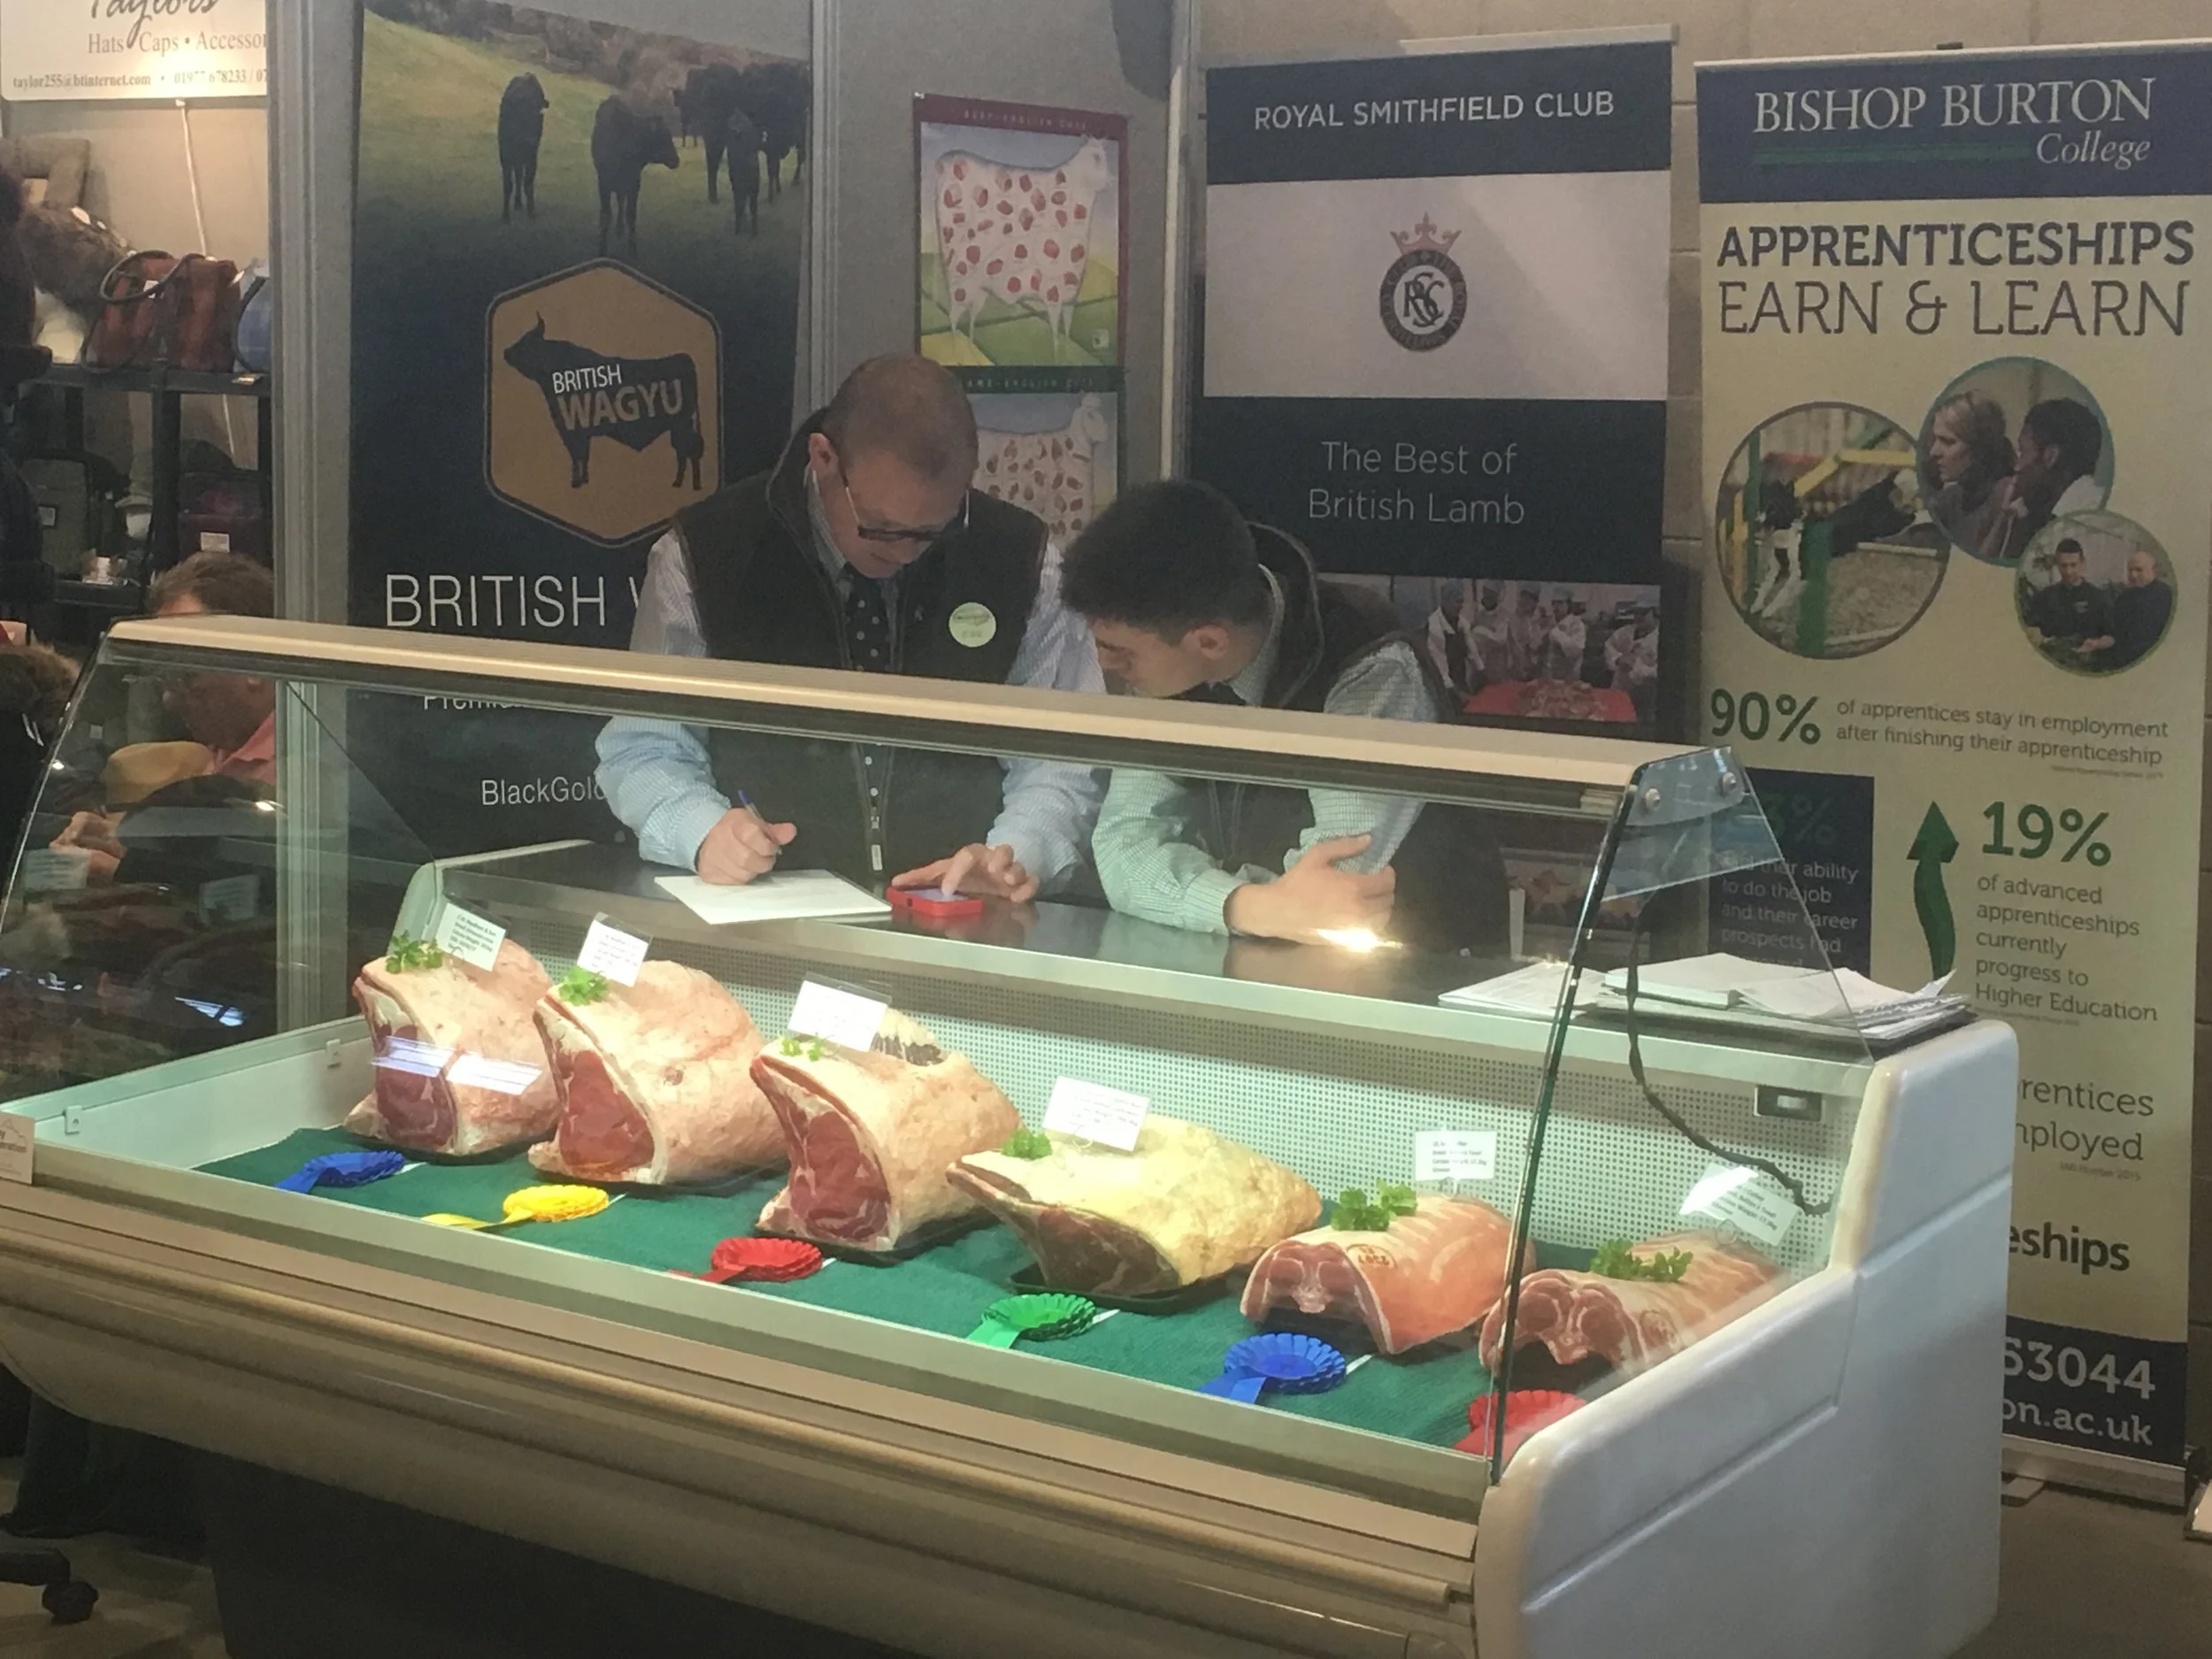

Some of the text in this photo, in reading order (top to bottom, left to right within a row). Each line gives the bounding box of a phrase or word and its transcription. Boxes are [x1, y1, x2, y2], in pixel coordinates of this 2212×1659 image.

[87, 33, 124, 54] Hats
[139, 31, 180, 58] Caps
[1255, 91, 1615, 130] ROYAL SMITHFIELD CLUB
[1754, 77, 2156, 134] BISHOP BURTON
[2037, 131, 2151, 170] College
[1717, 220, 2194, 267] APPRENTICESHIPS
[1719, 280, 2190, 336] EARN & LEARN
[552, 364, 623, 395] BRITISH
[557, 379, 683, 431] WAGYU
[1322, 442, 1517, 475] The Best of
[1309, 488, 1525, 525] British Lamb
[387, 574, 605, 627] BRITISH
[1711, 688, 1822, 745] 90%
[1837, 699, 2169, 740] of apprentices stay in employment
[1836, 725, 2163, 767] after finishing their apprenticeship
[1982, 801, 2112, 867] 19%
[1722, 879, 1740, 895] to
[1743, 880, 1766, 897] do
[1803, 861, 1859, 885] ability
[1978, 873, 2103, 904] of advanced
[1722, 903, 1859, 930] and their career
[1976, 903, 2140, 938] apprenticeships
[1722, 929, 1805, 949] prospects
[1976, 932, 2068, 960] currently
[1976, 959, 2089, 987] progress to
[1975, 983, 2043, 1008] Higher
[2049, 993, 2158, 1021] Education
[2009, 1221, 2131, 1275] eships
[2002, 1399, 2153, 1446] on.ac.uk
